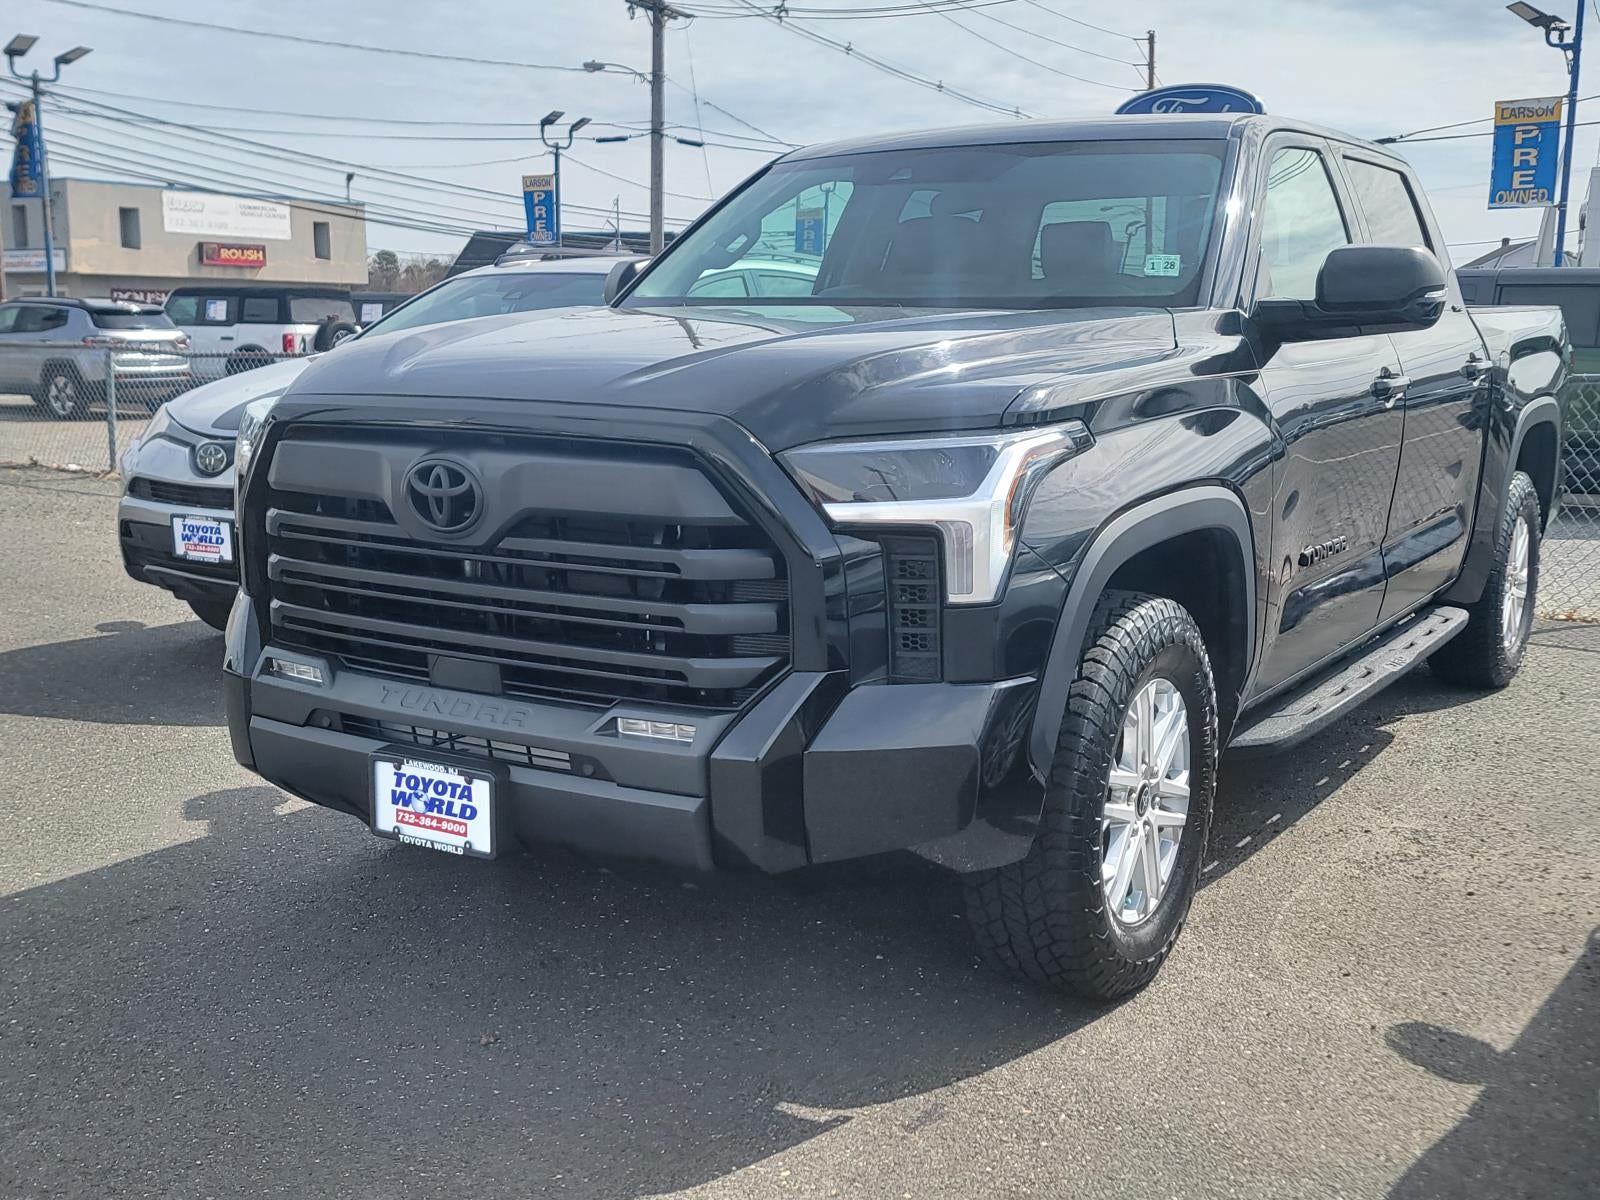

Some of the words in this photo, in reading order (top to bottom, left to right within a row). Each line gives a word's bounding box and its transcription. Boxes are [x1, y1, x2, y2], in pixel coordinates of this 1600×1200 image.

[1512, 125, 1540, 190] PRE
[1495, 188, 1548, 205] OWNED
[533, 191, 547, 232] PRE
[530, 231, 553, 241] OWNED
[220, 247, 263, 261] ROUSH
[1163, 261, 1176, 270] 28
[182, 523, 221, 535] TOYOTA
[181, 533, 224, 545] WORLD
[380, 685, 531, 728] TUNDRA
[448, 767, 459, 776] NJ
[393, 771, 473, 802] TOYOTA
[391, 789, 478, 821] WORLD
[398, 834, 432, 849] TOYOTA
[433, 841, 464, 855] WORLD
